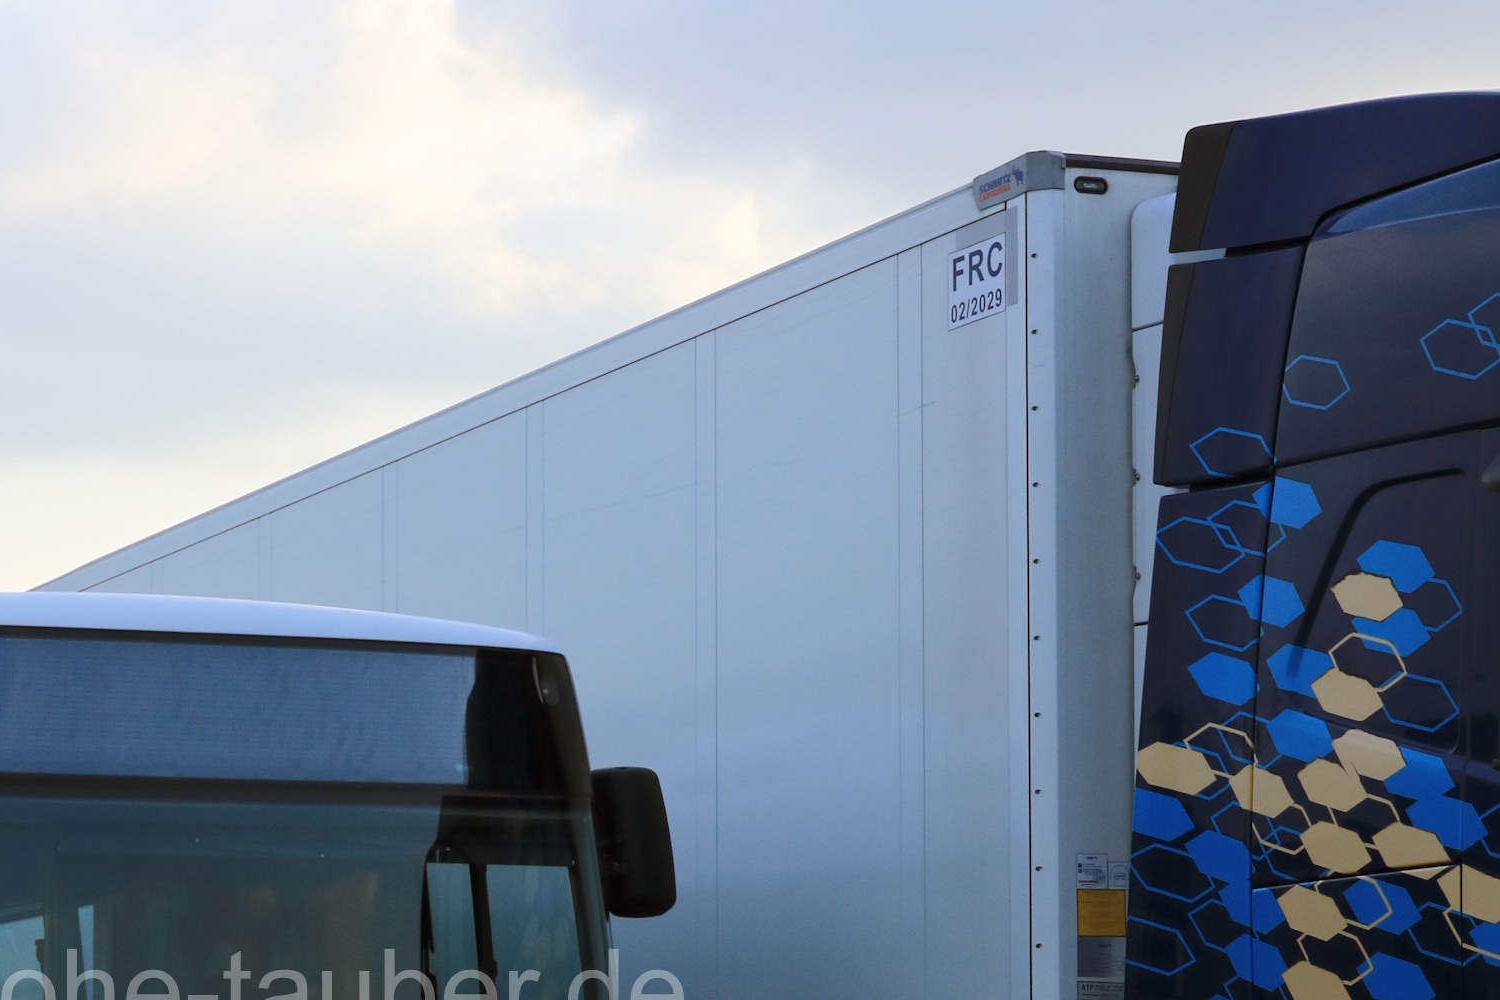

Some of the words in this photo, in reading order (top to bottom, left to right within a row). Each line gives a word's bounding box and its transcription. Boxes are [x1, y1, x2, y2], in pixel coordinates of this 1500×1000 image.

[952, 241, 1003, 291] FRC
[951, 289, 1002, 323] 02/2029
[1081, 983, 1094, 991] ATP
